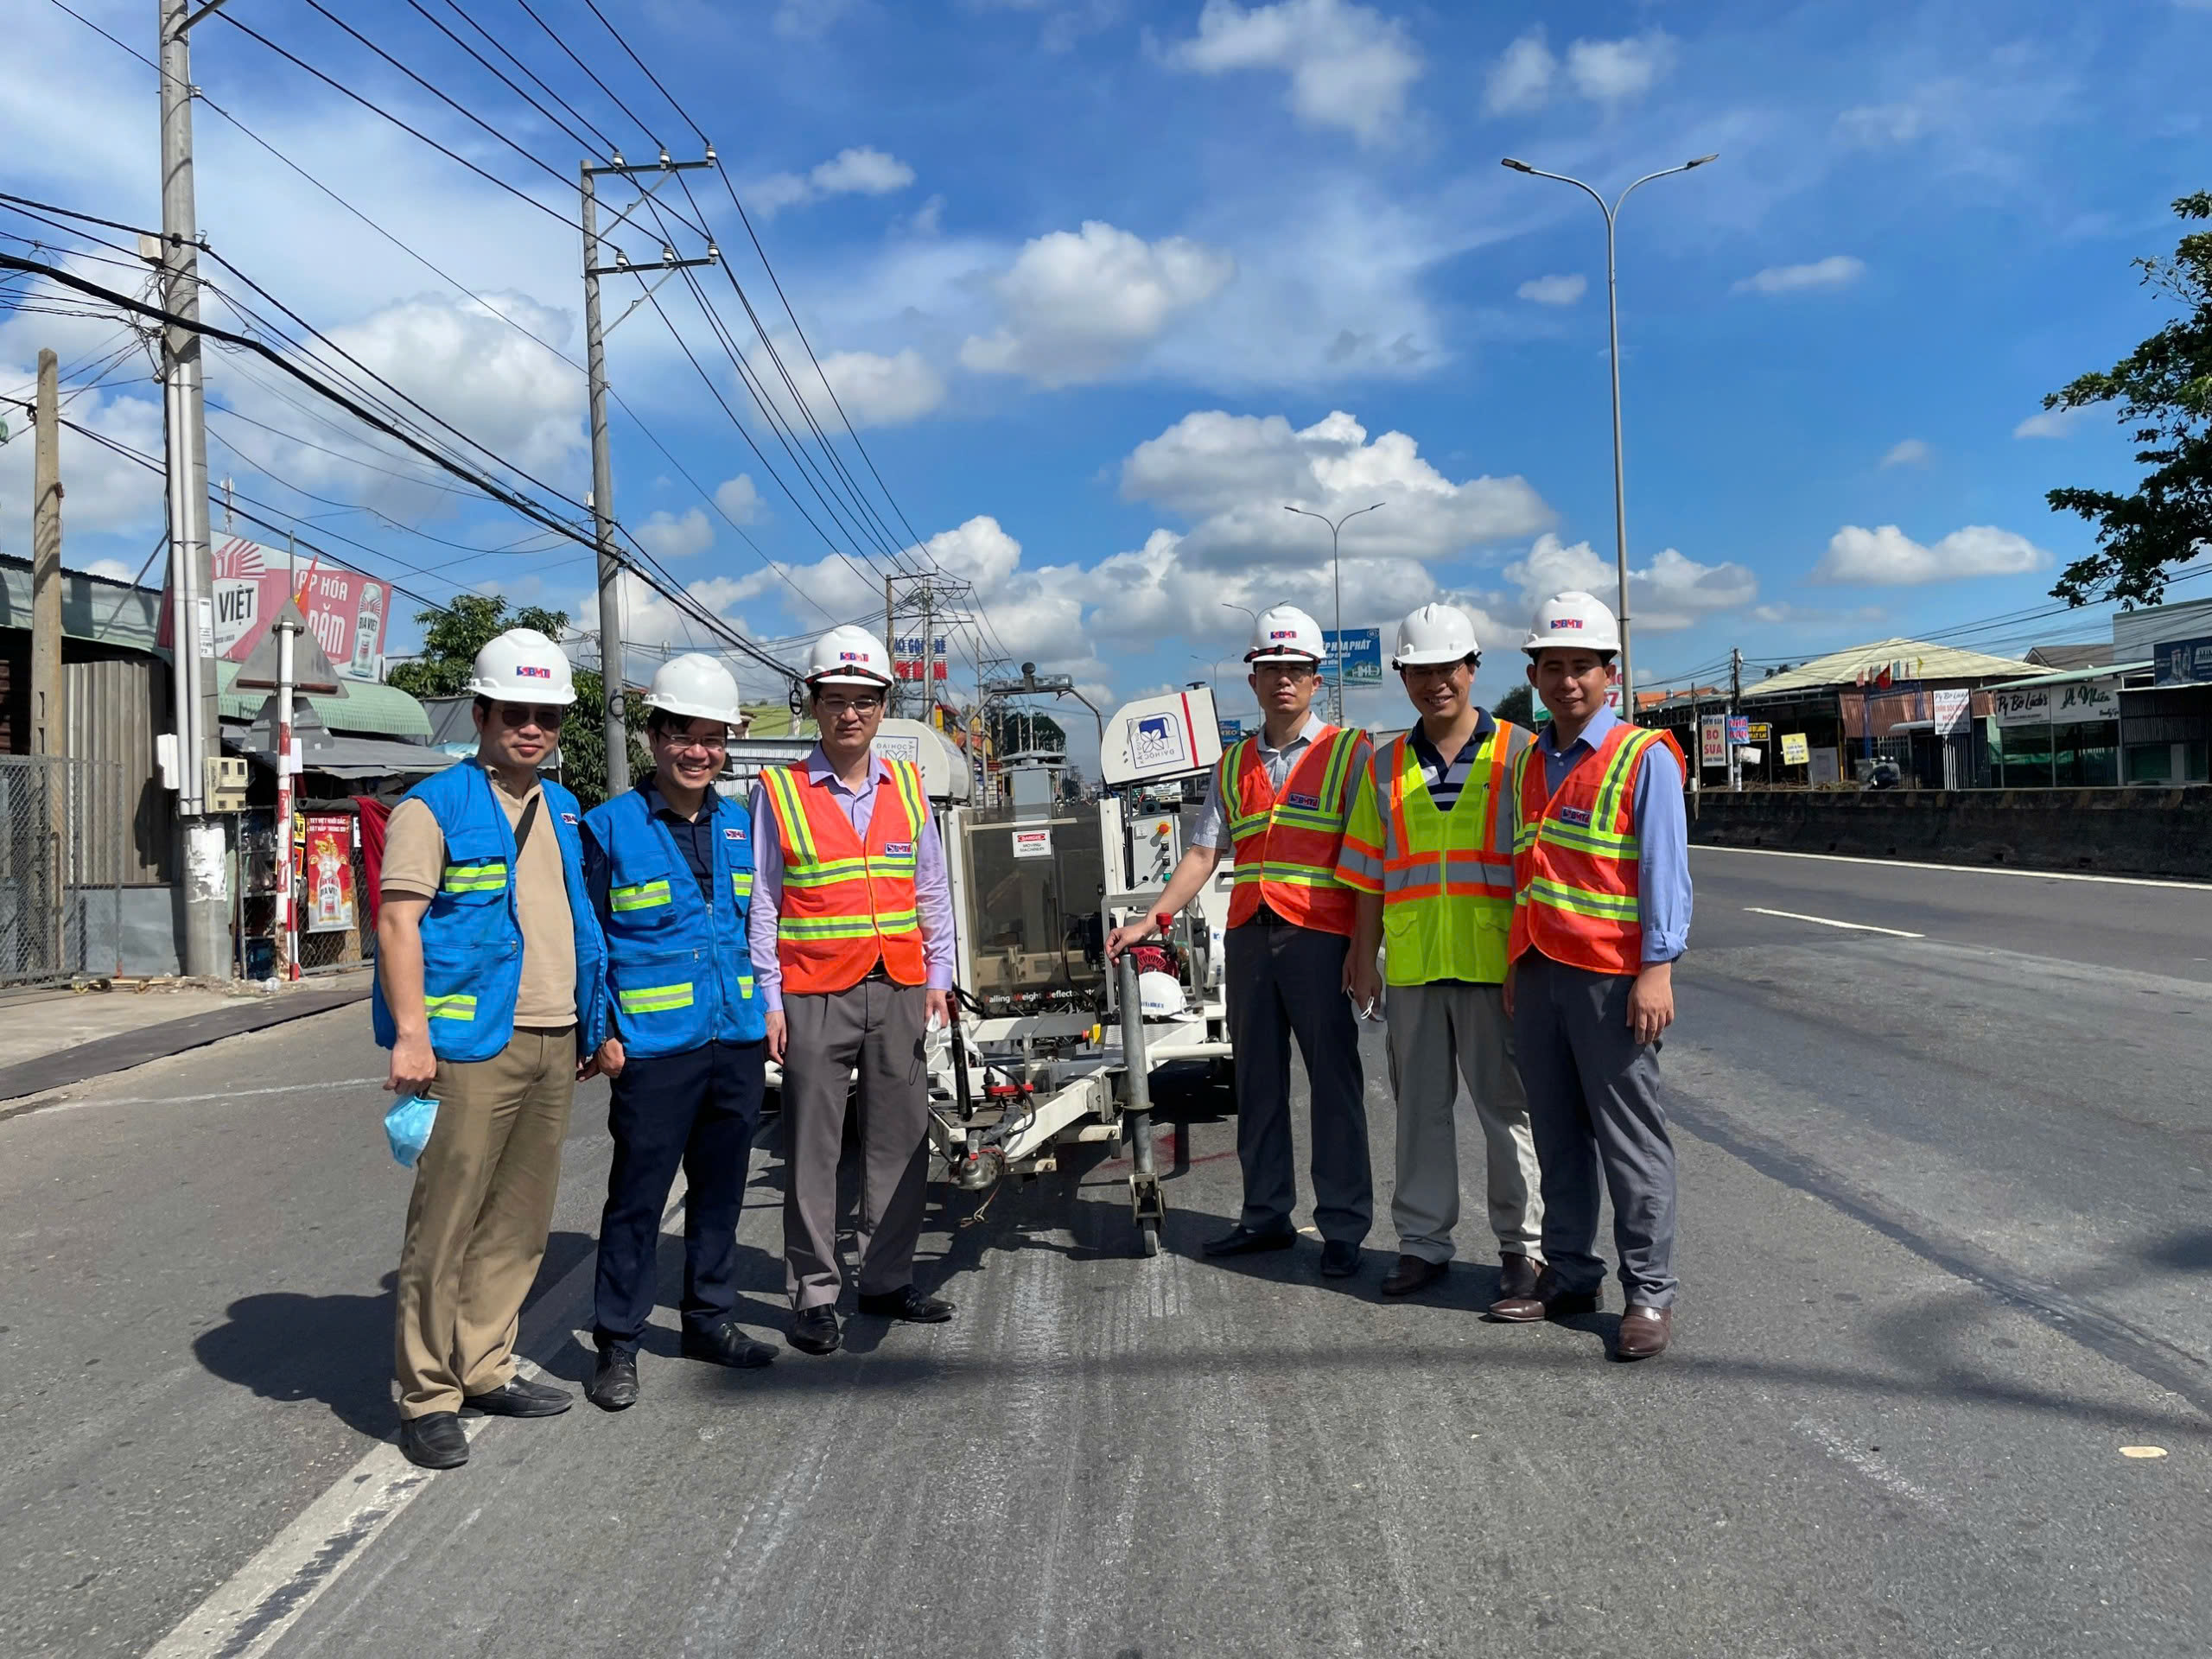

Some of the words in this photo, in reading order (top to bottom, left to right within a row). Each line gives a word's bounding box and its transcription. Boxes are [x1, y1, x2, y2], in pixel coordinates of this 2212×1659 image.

[321, 576, 348, 601] HÓA
[218, 583, 254, 626] VIỆT
[1550, 619, 1583, 629] SBMT
[1270, 631, 1297, 639] SBMT
[1350, 639, 1371, 651] PHÁT
[839, 652, 868, 662] SBMT
[517, 666, 550, 678] SBMT
